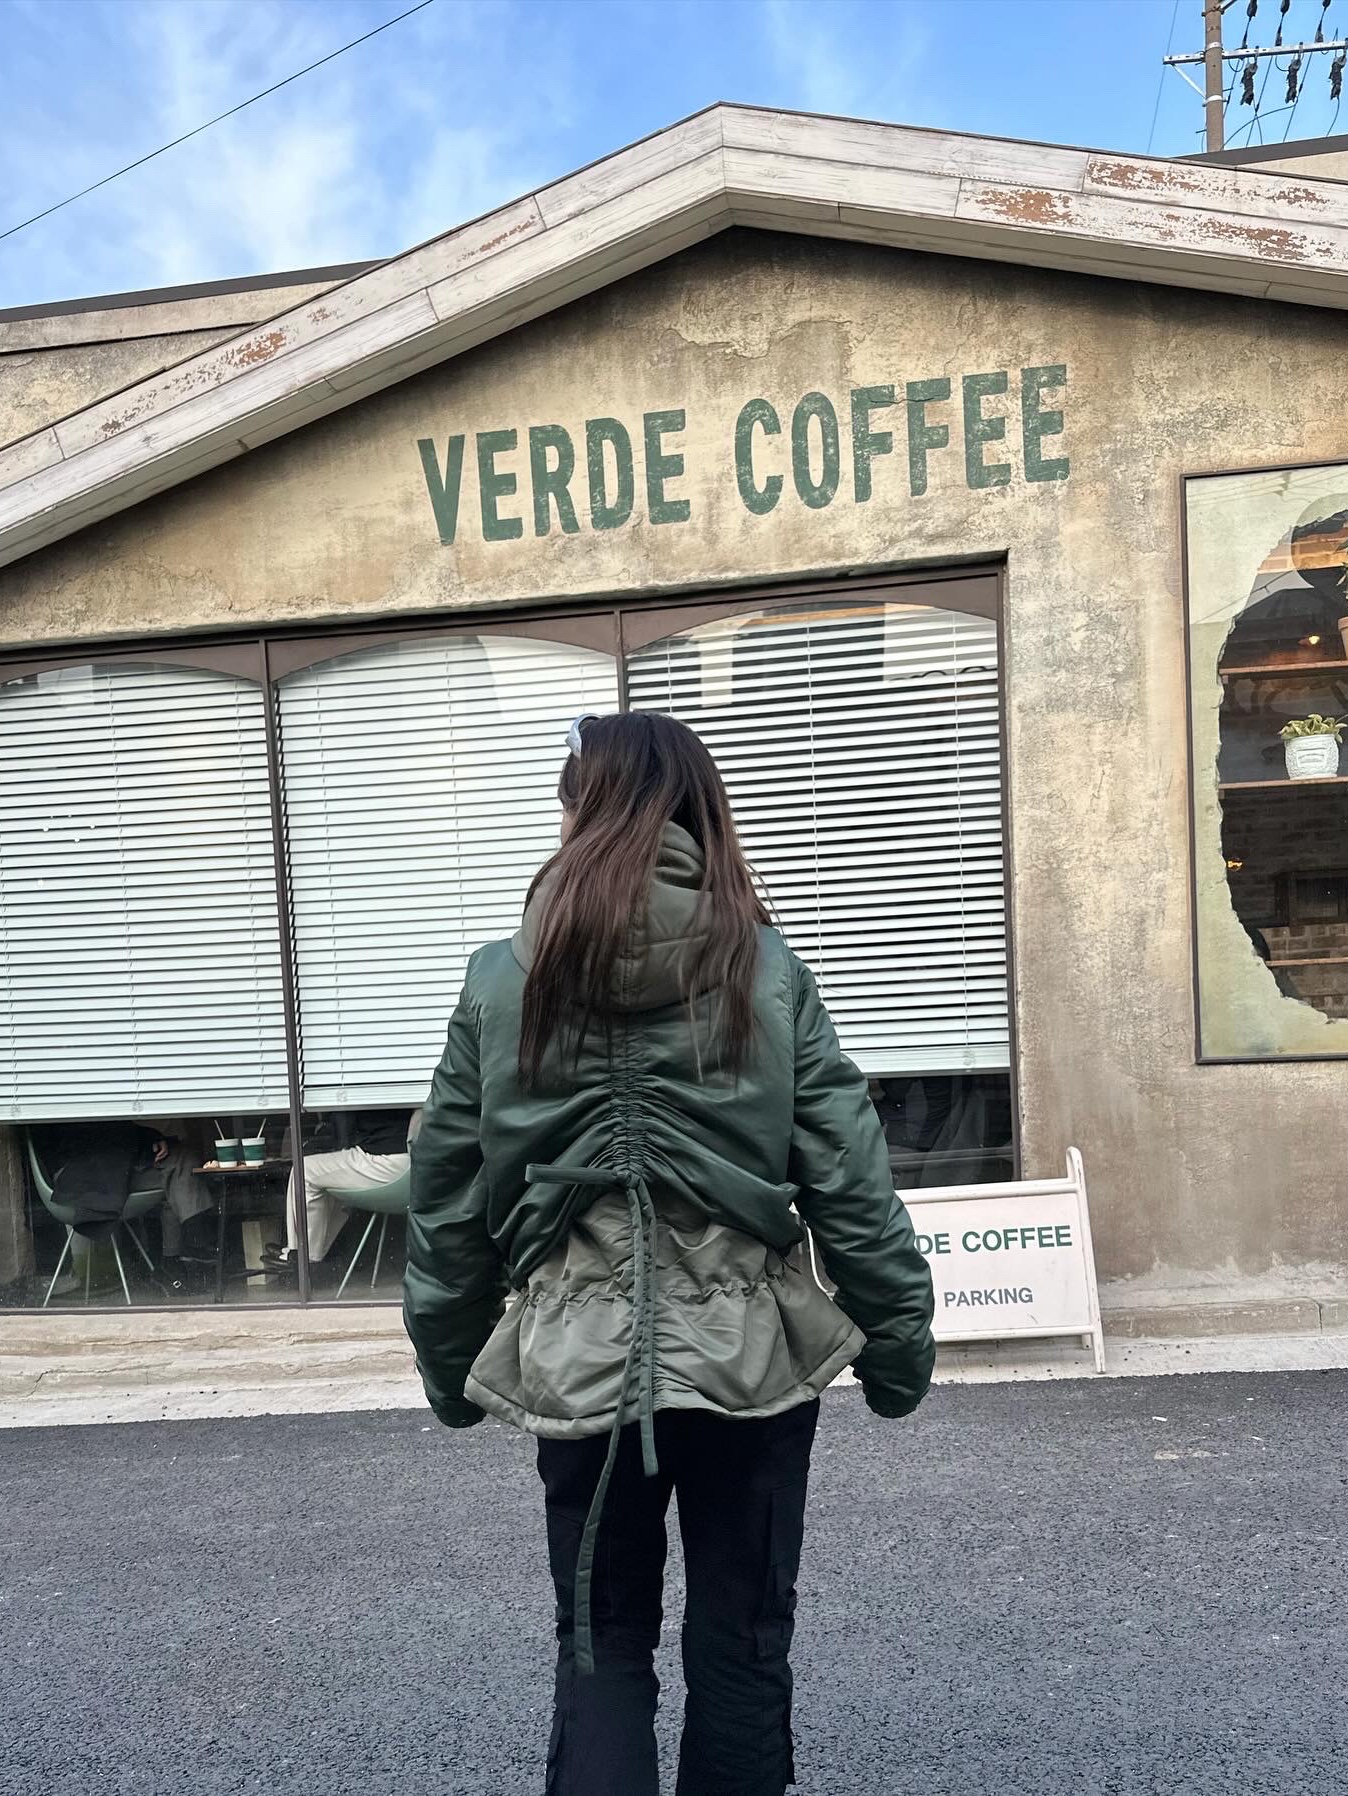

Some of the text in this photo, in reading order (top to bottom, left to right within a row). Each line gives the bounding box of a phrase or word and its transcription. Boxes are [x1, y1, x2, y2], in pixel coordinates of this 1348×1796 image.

[418, 364, 1070, 546] VERDE COFFEE
[962, 1225, 1073, 1252] COFFEE
[943, 1287, 1034, 1308] PARKING
